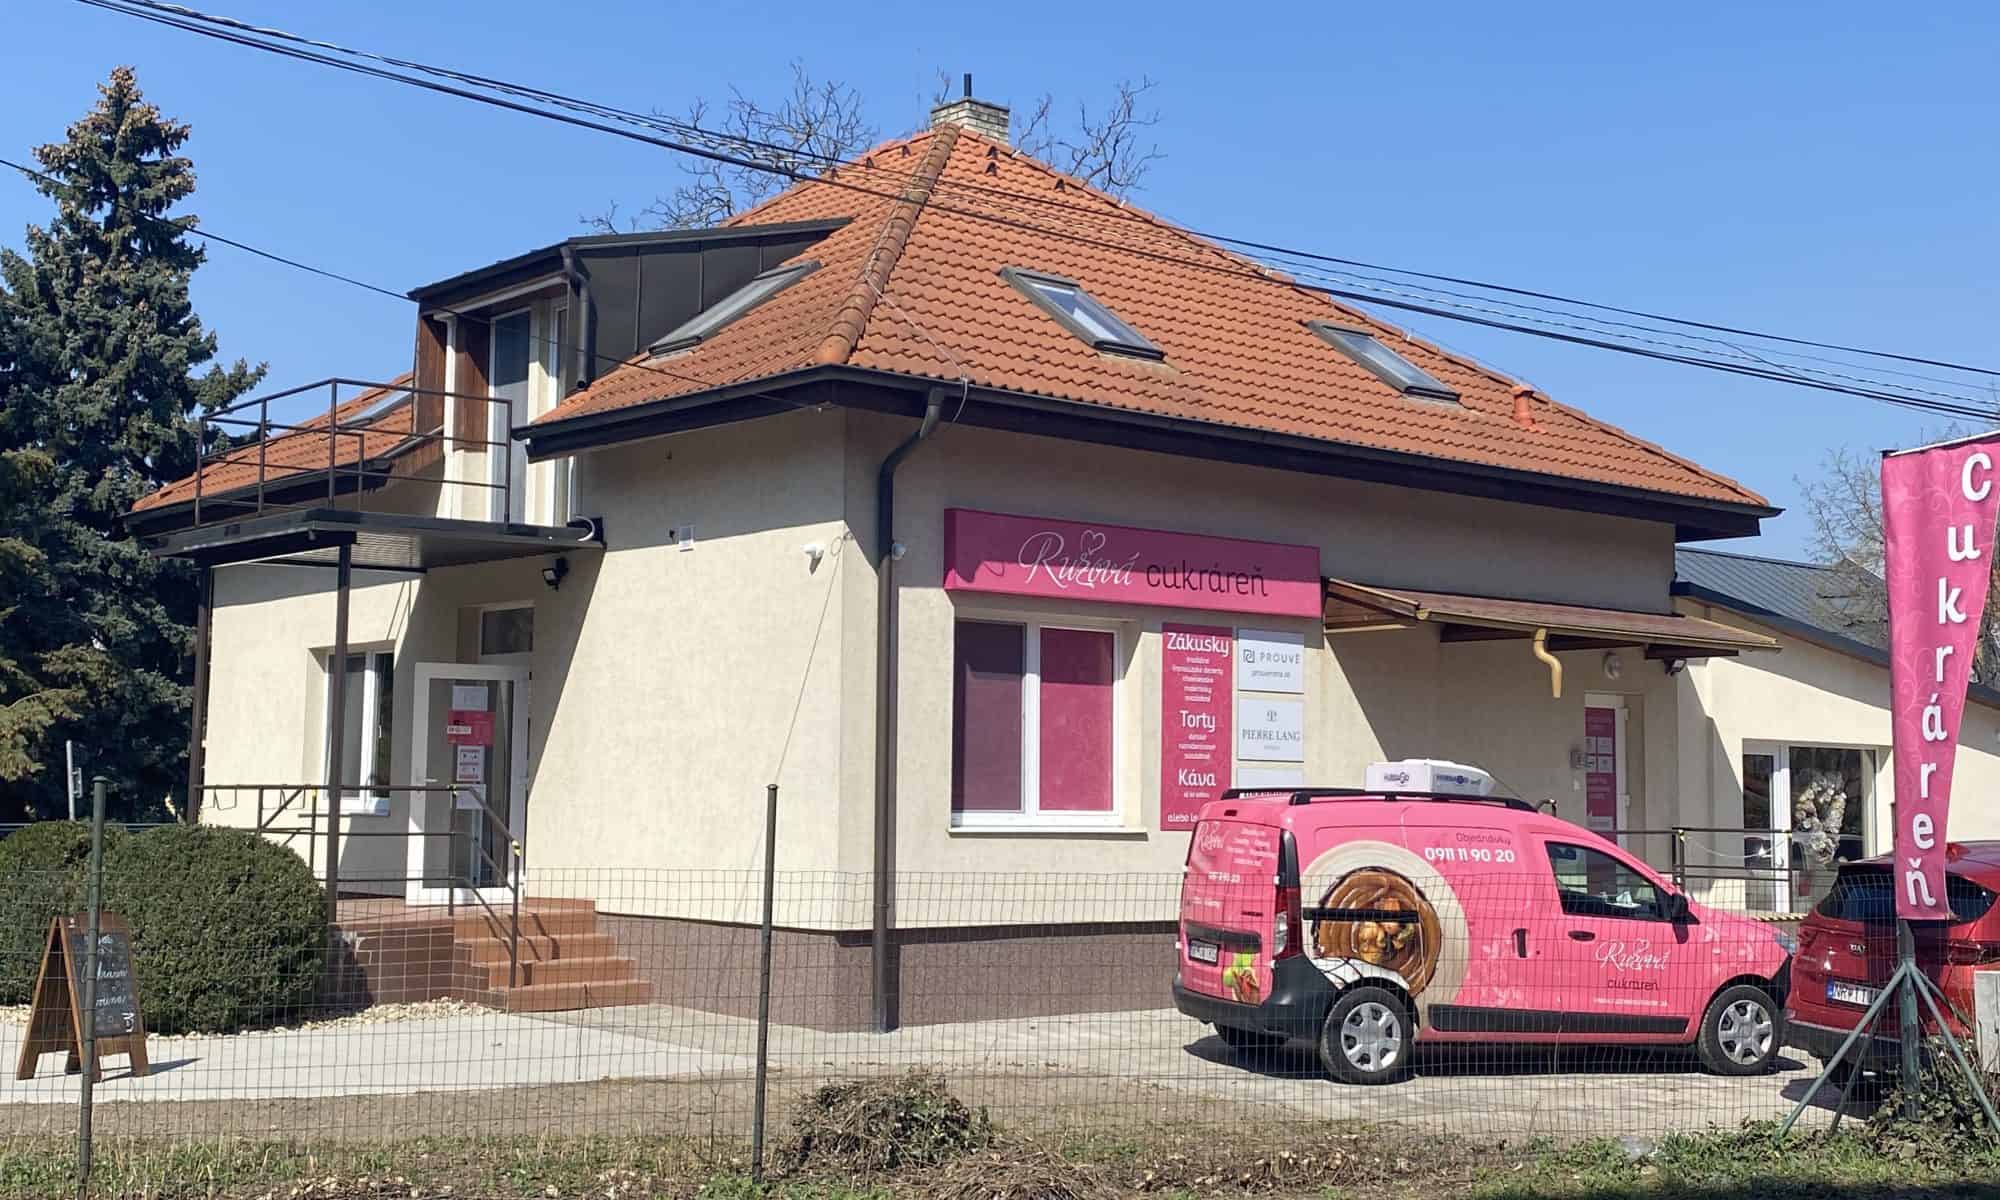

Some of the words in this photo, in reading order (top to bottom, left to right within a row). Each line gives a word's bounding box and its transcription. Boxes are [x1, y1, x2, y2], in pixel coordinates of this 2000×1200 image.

[1017, 529, 1140, 589] Ružová
[1146, 561, 1268, 597] cukráreň
[1167, 632, 1230, 658] Zákusky
[1179, 709, 1216, 734] Torty
[1242, 728, 1274, 741] PIERRE
[1275, 729, 1301, 742] LANG
[1178, 767, 1217, 787] Káva
[1424, 847, 1454, 862] 0911
[1458, 848, 1468, 862] 11
[1471, 848, 1491, 863] 90
[1495, 849, 1515, 863] 20
